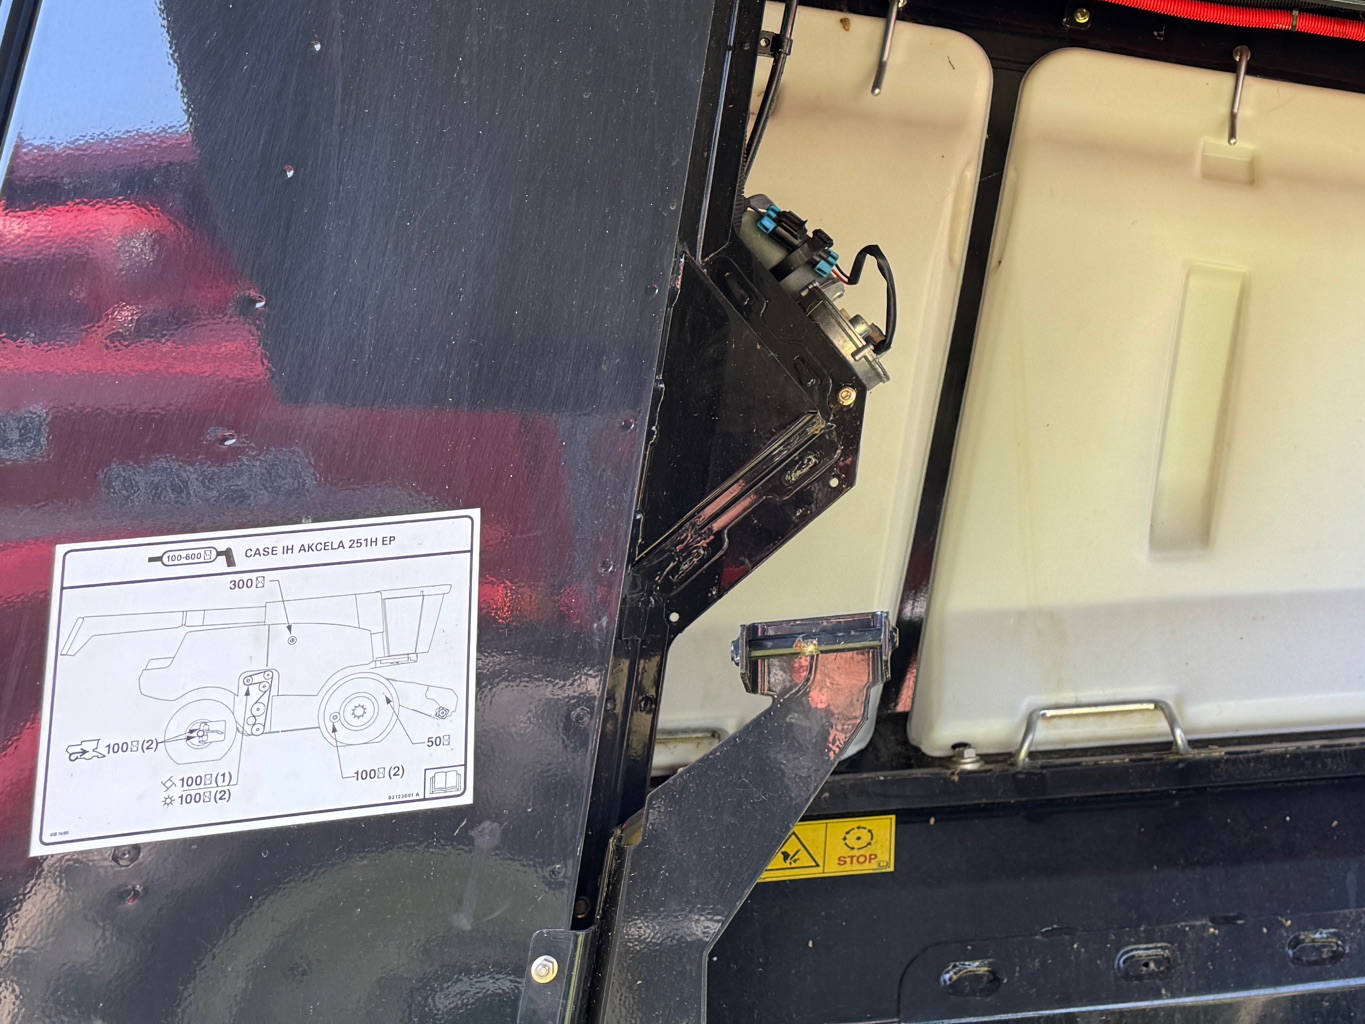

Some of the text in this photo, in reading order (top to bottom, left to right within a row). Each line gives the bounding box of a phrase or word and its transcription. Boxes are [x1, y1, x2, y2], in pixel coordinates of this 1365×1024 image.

[245, 536, 396, 558] CASE IH AKCELA 251H EP
[166, 552, 202, 562] 100-600
[229, 578, 253, 590] 300
[427, 736, 442, 747] 50
[837, 853, 878, 866] STOP
